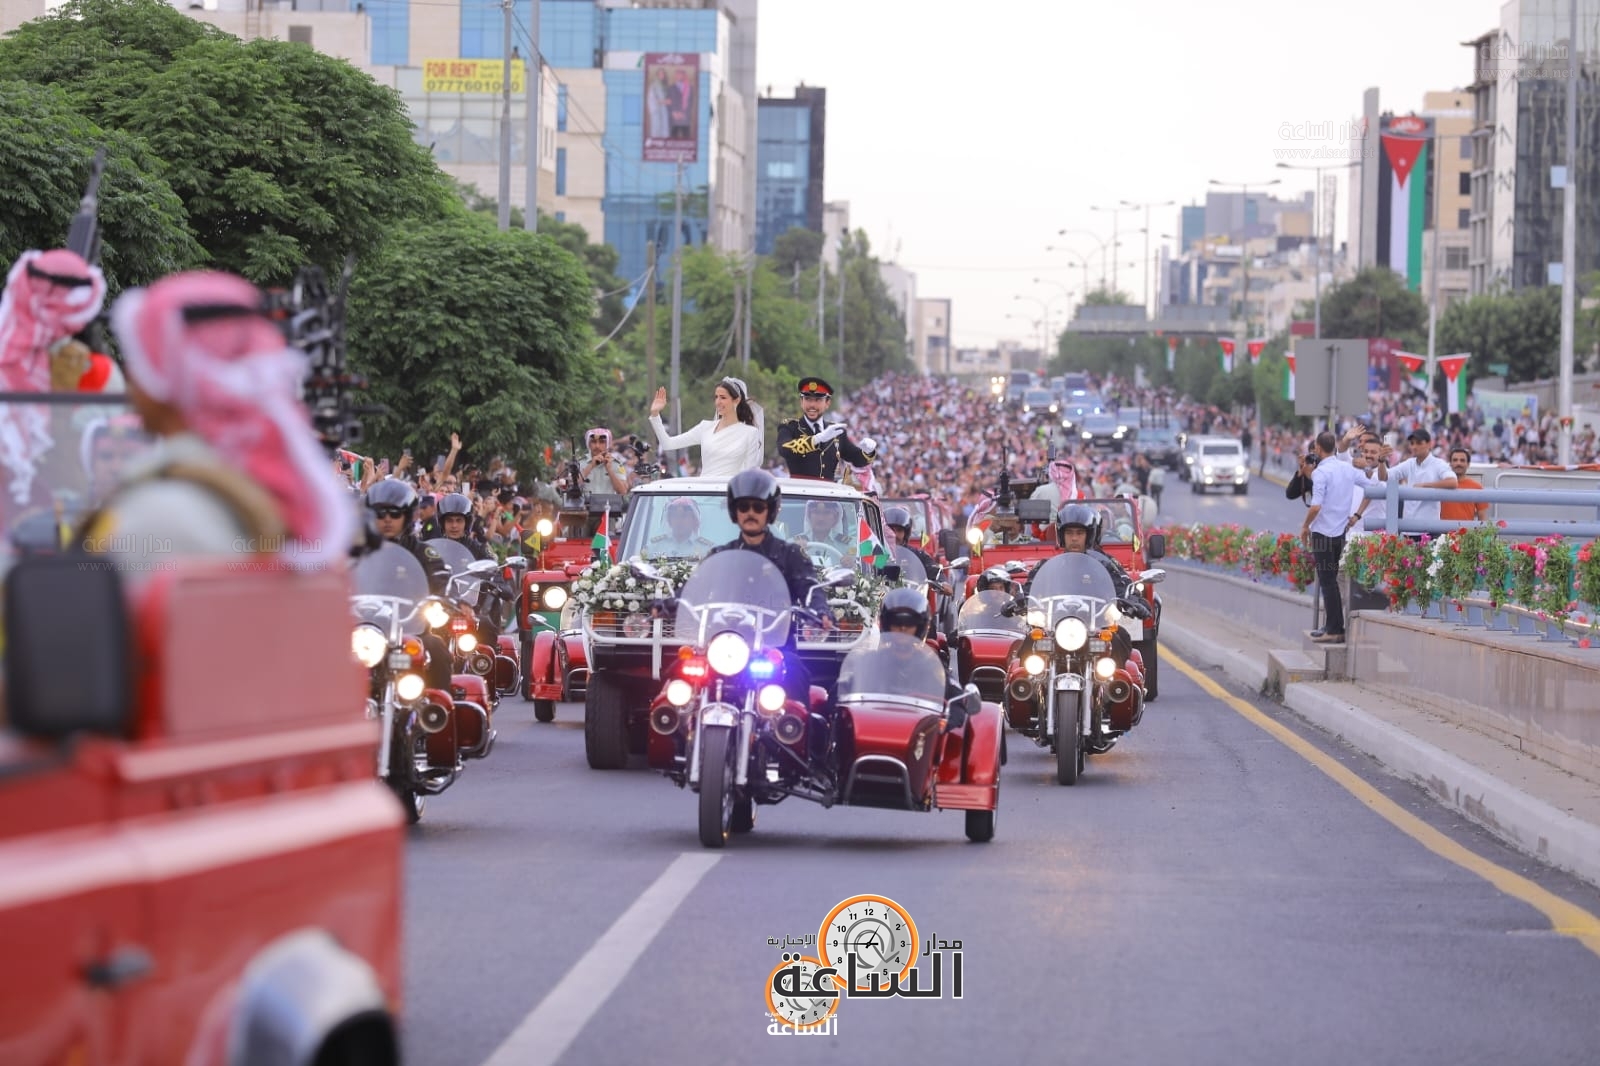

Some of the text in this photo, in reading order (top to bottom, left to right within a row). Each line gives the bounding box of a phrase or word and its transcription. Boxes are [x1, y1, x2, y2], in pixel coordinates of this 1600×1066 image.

[427, 62, 446, 78] FOR
[450, 62, 477, 78] RENT
[426, 79, 520, 92] 077760100
